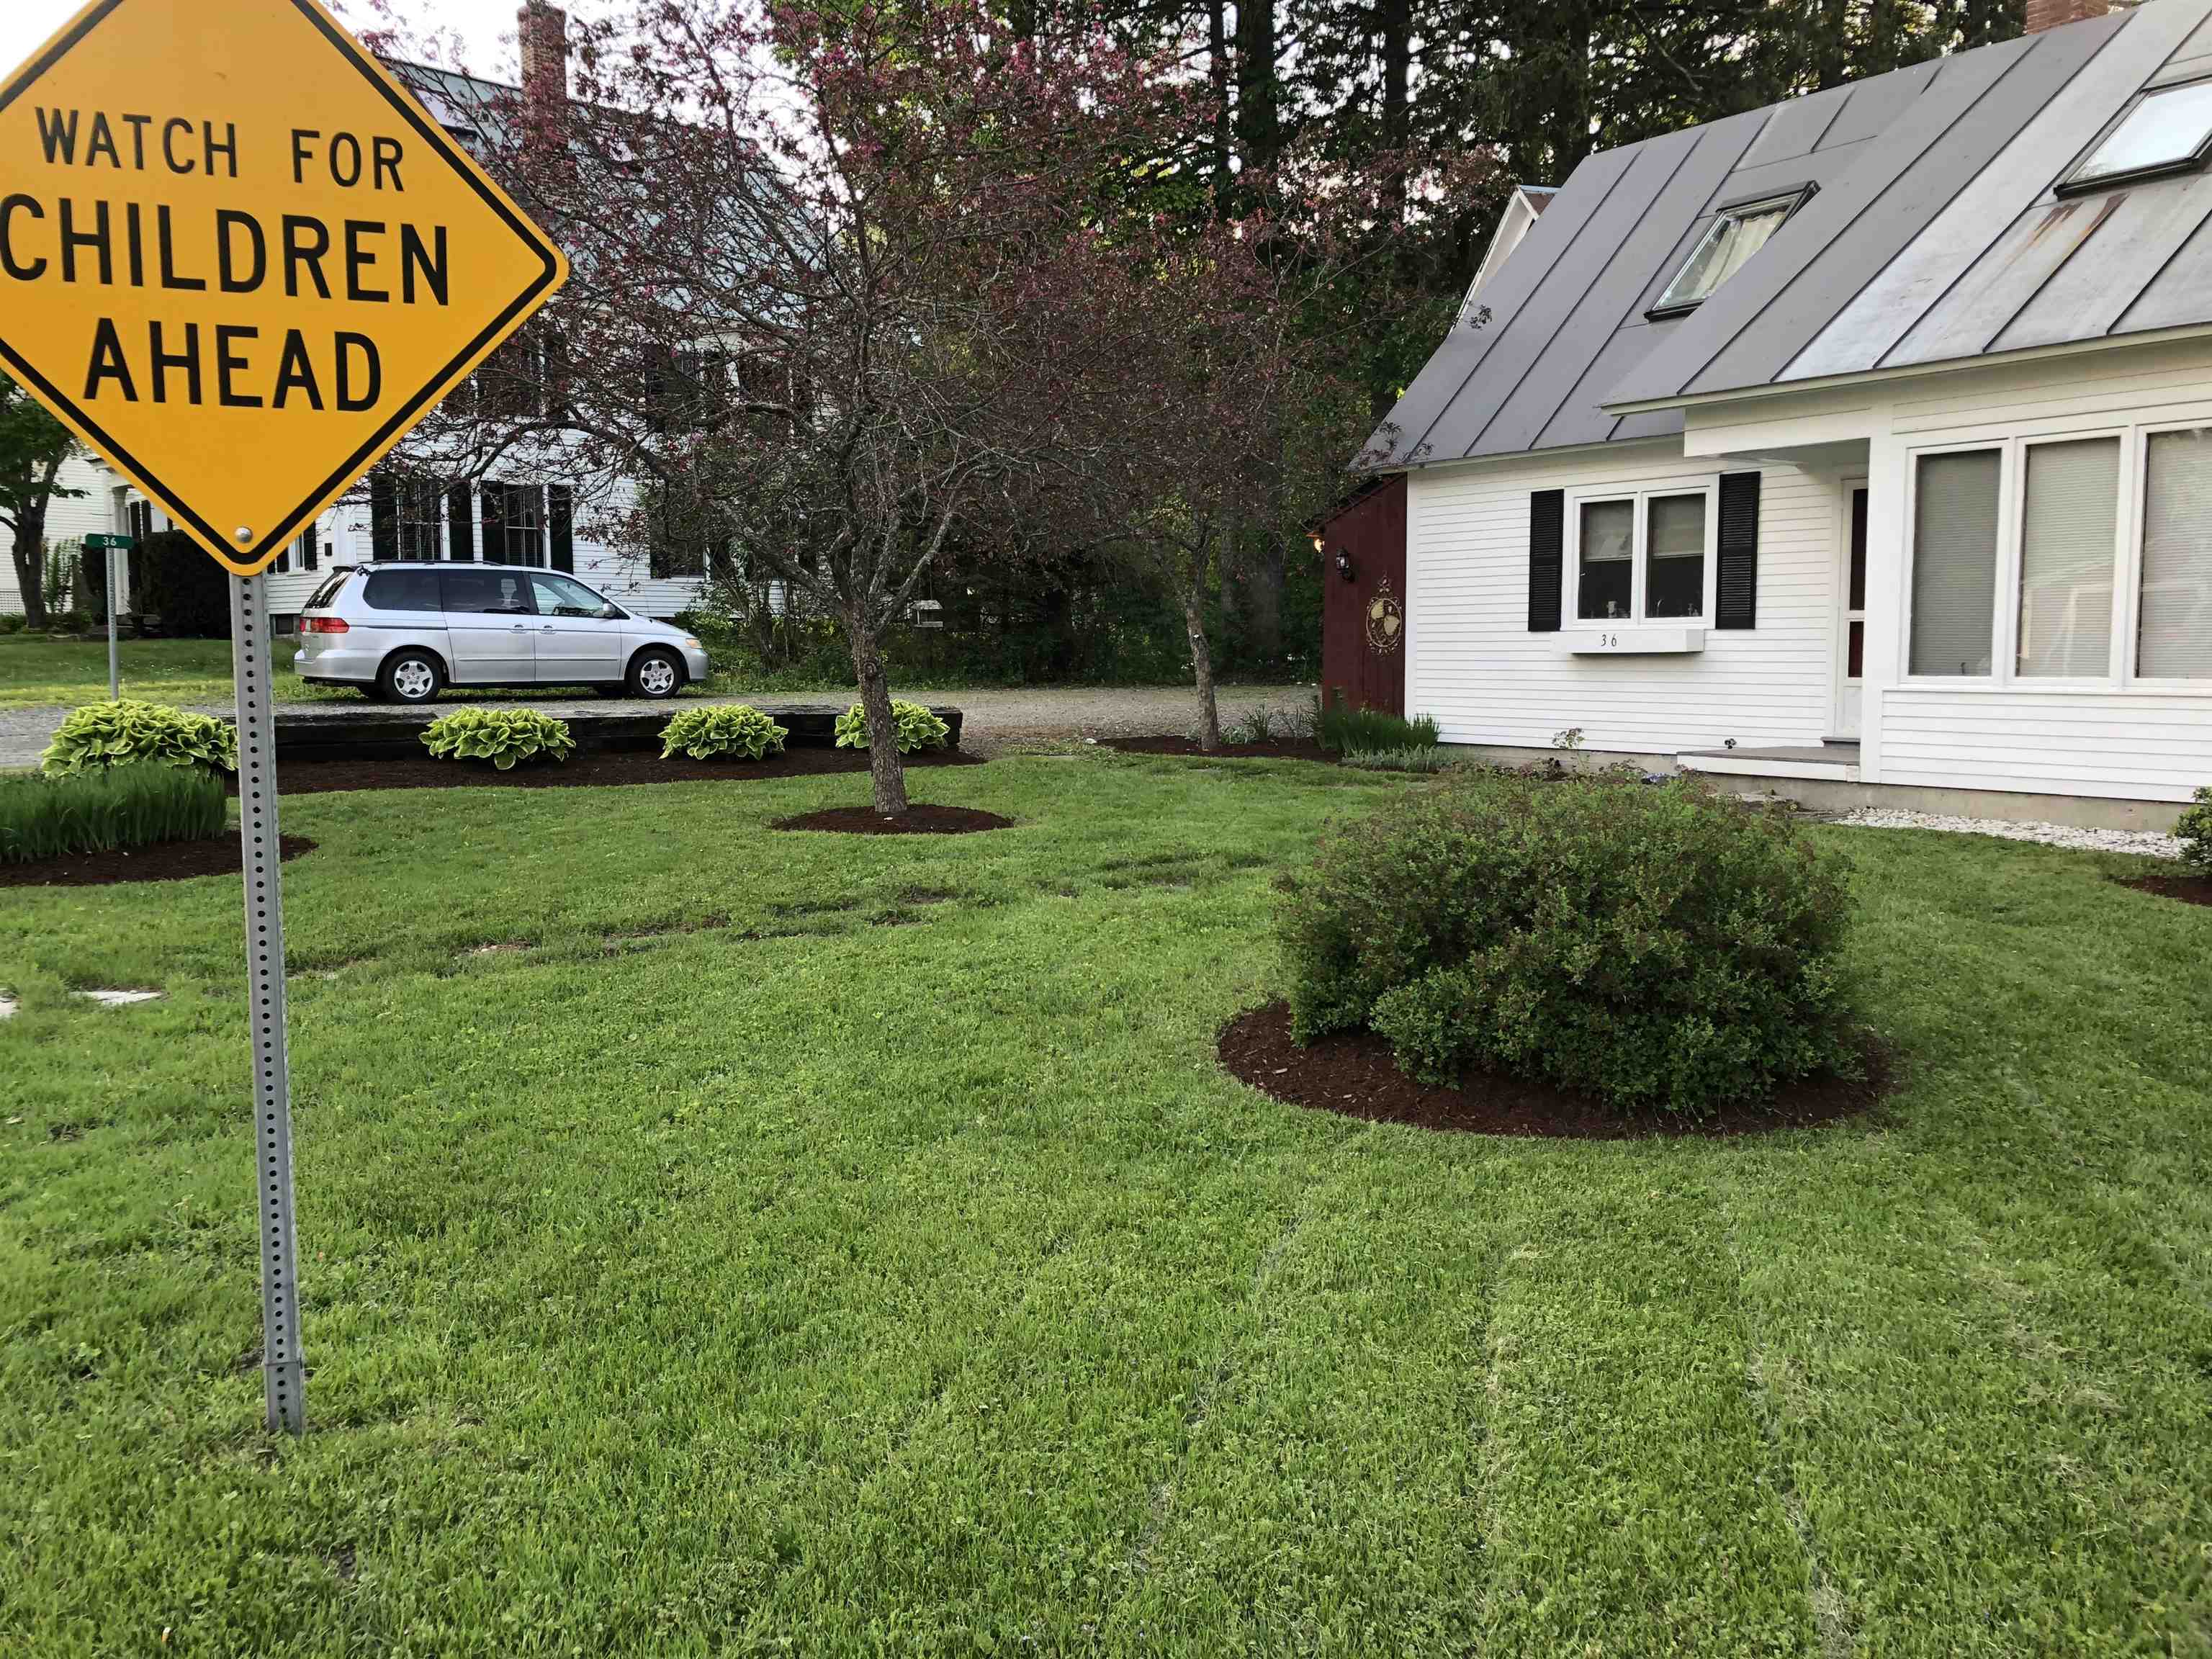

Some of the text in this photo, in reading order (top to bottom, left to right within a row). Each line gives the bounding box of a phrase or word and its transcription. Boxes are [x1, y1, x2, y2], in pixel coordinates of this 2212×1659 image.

[35, 107, 405, 192] WATCH FOR
[0, 194, 449, 306] CHILDREN
[84, 318, 382, 413] AHEAD
[103, 536, 117, 547] 36
[1601, 634, 1617, 647] 36
